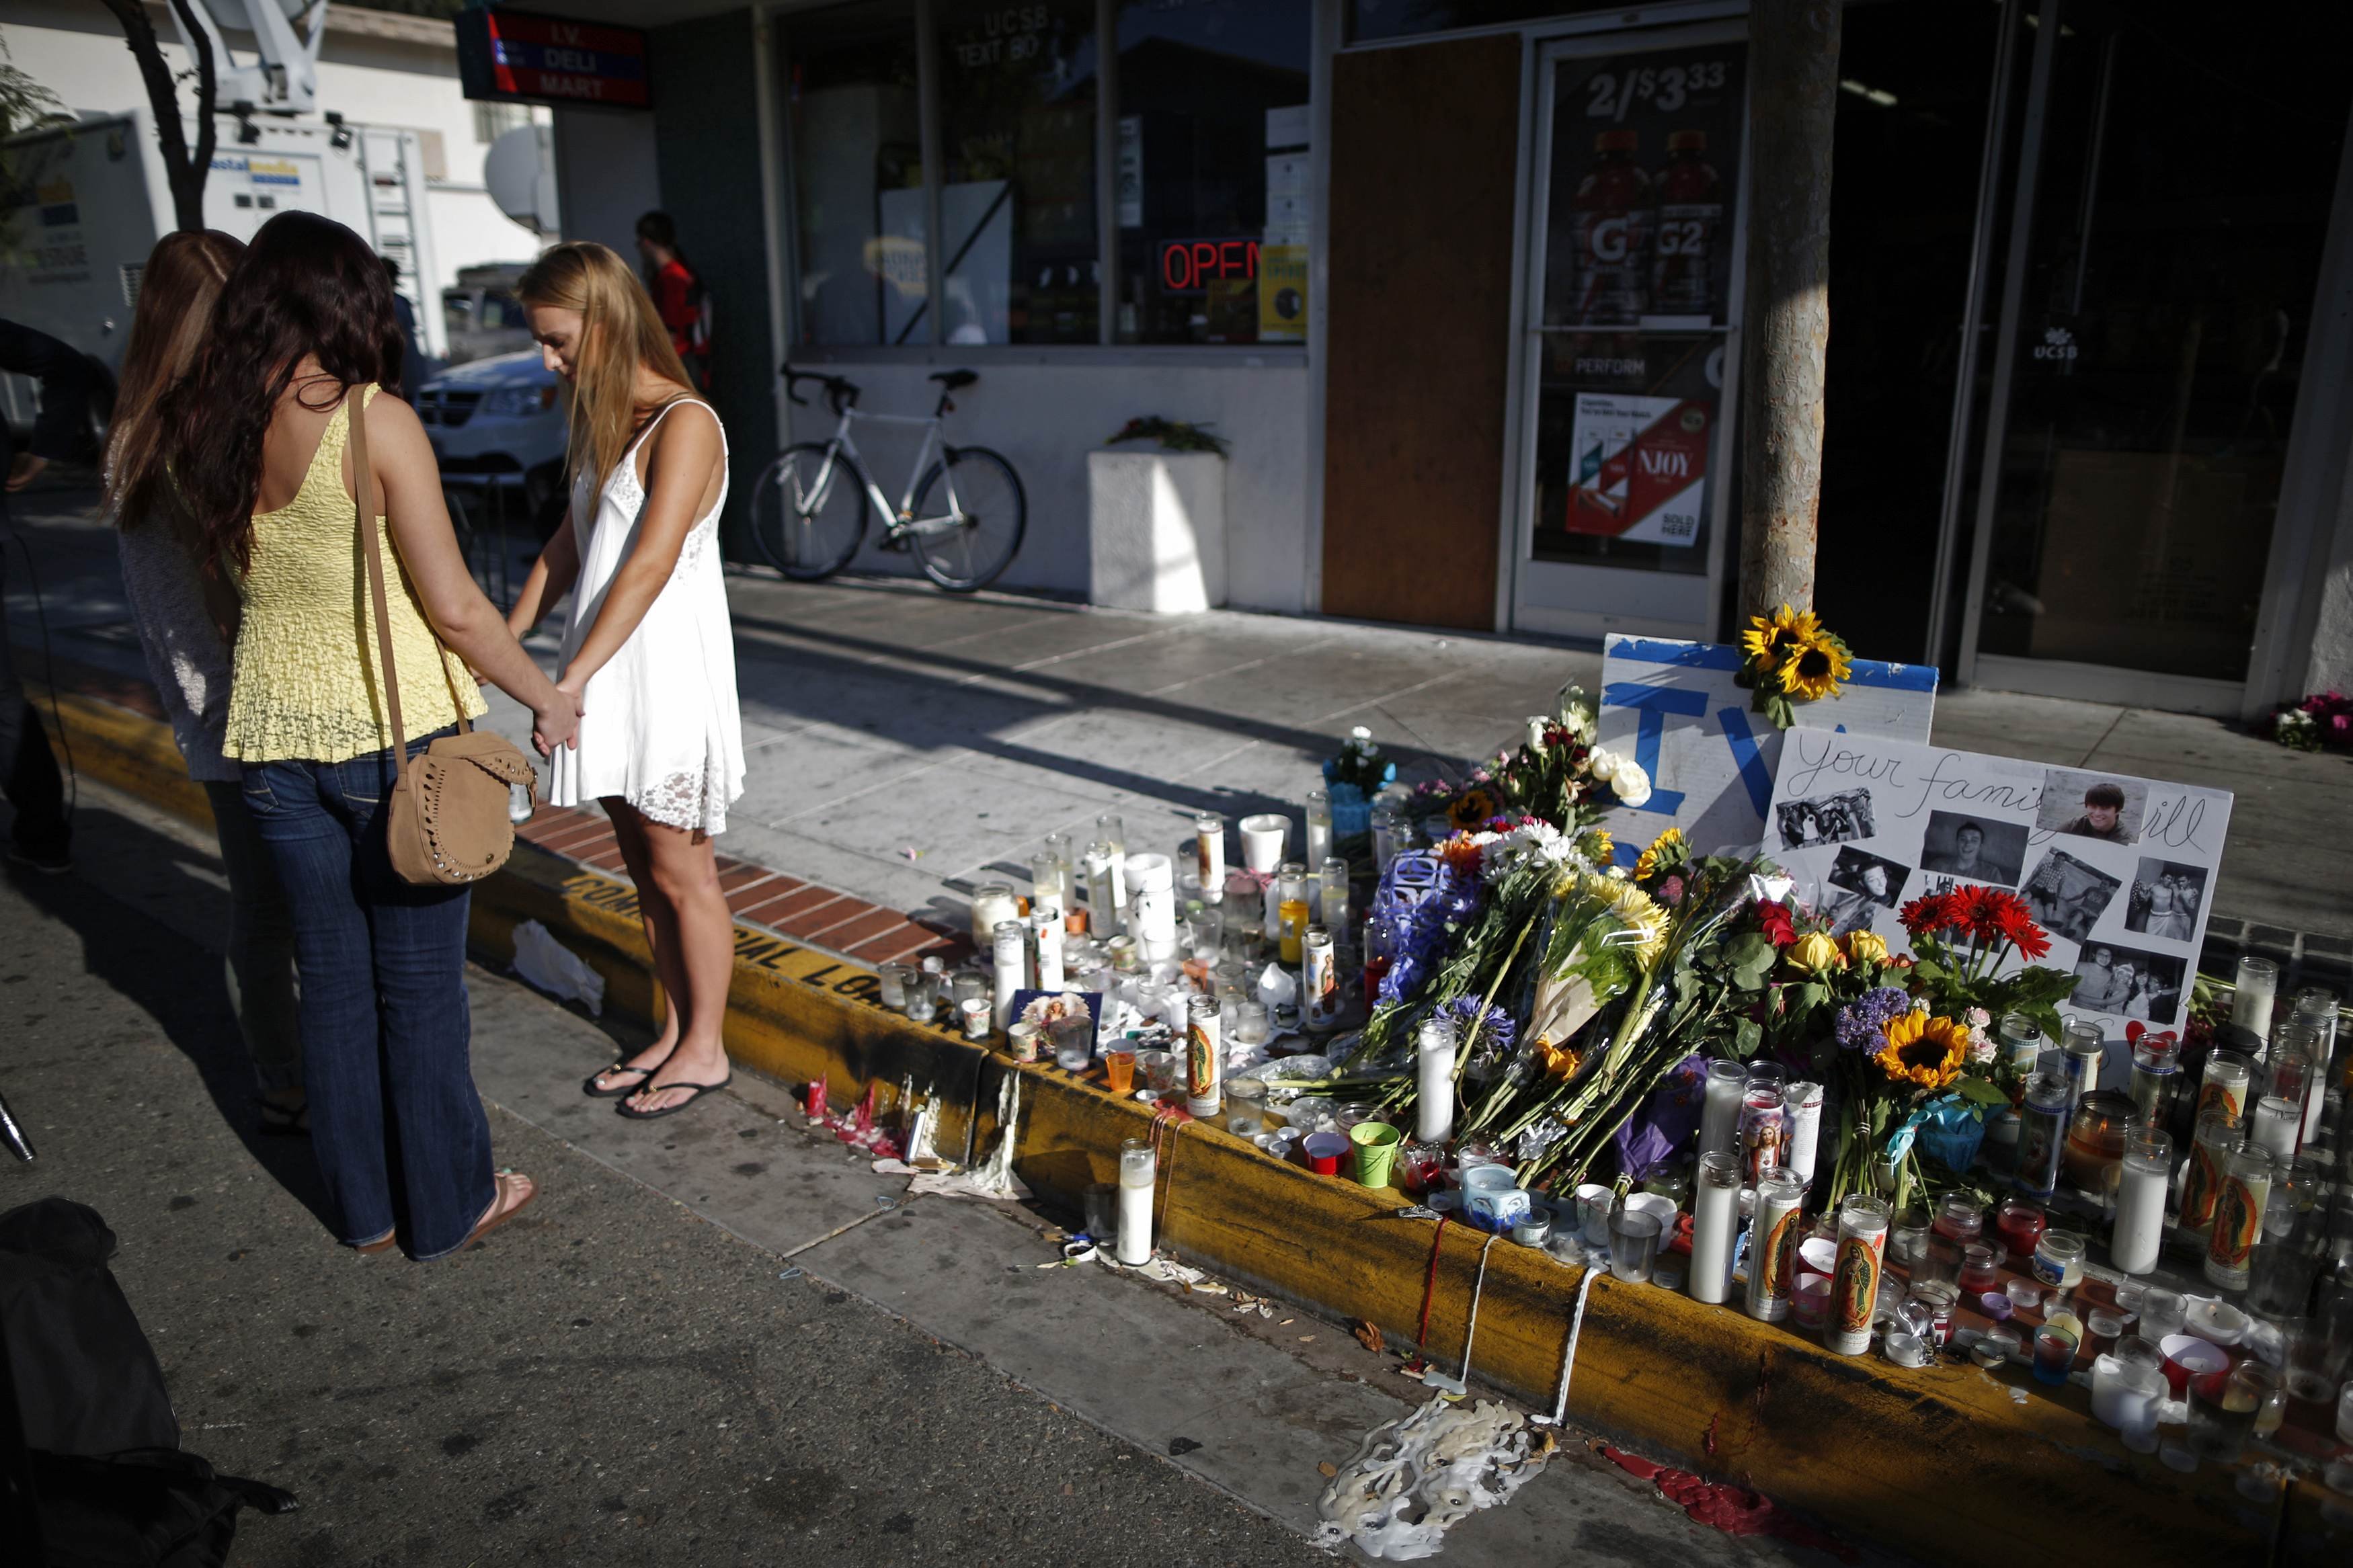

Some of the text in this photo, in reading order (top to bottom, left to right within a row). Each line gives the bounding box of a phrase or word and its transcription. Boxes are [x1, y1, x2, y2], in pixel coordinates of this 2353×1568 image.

[543, 47, 598, 73] DELI
[539, 74, 604, 100] MART
[2033, 345, 2079, 360] UCSB
[1574, 358, 1646, 376] PERFORM
